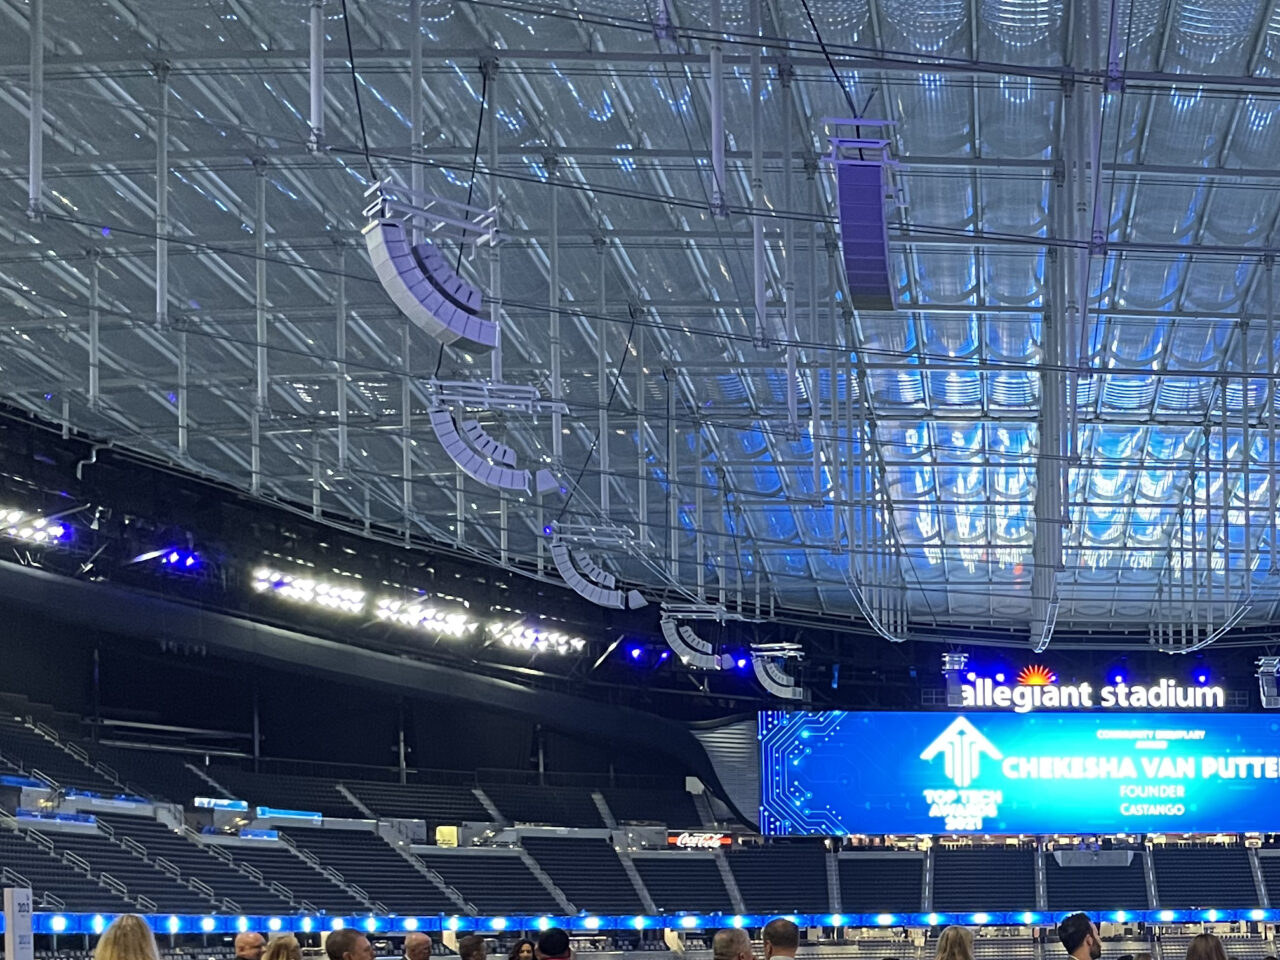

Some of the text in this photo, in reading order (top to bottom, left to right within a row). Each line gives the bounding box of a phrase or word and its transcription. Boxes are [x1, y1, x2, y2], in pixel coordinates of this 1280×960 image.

[961, 678, 1224, 712] allegiant stadium
[1002, 757, 1137, 778] CHEKESHA
[1141, 757, 1195, 778] VAN
[923, 789, 1002, 804] TOP TECH
[1120, 785, 1185, 797] FOUNDER
[1120, 803, 1185, 815] CASTANGO
